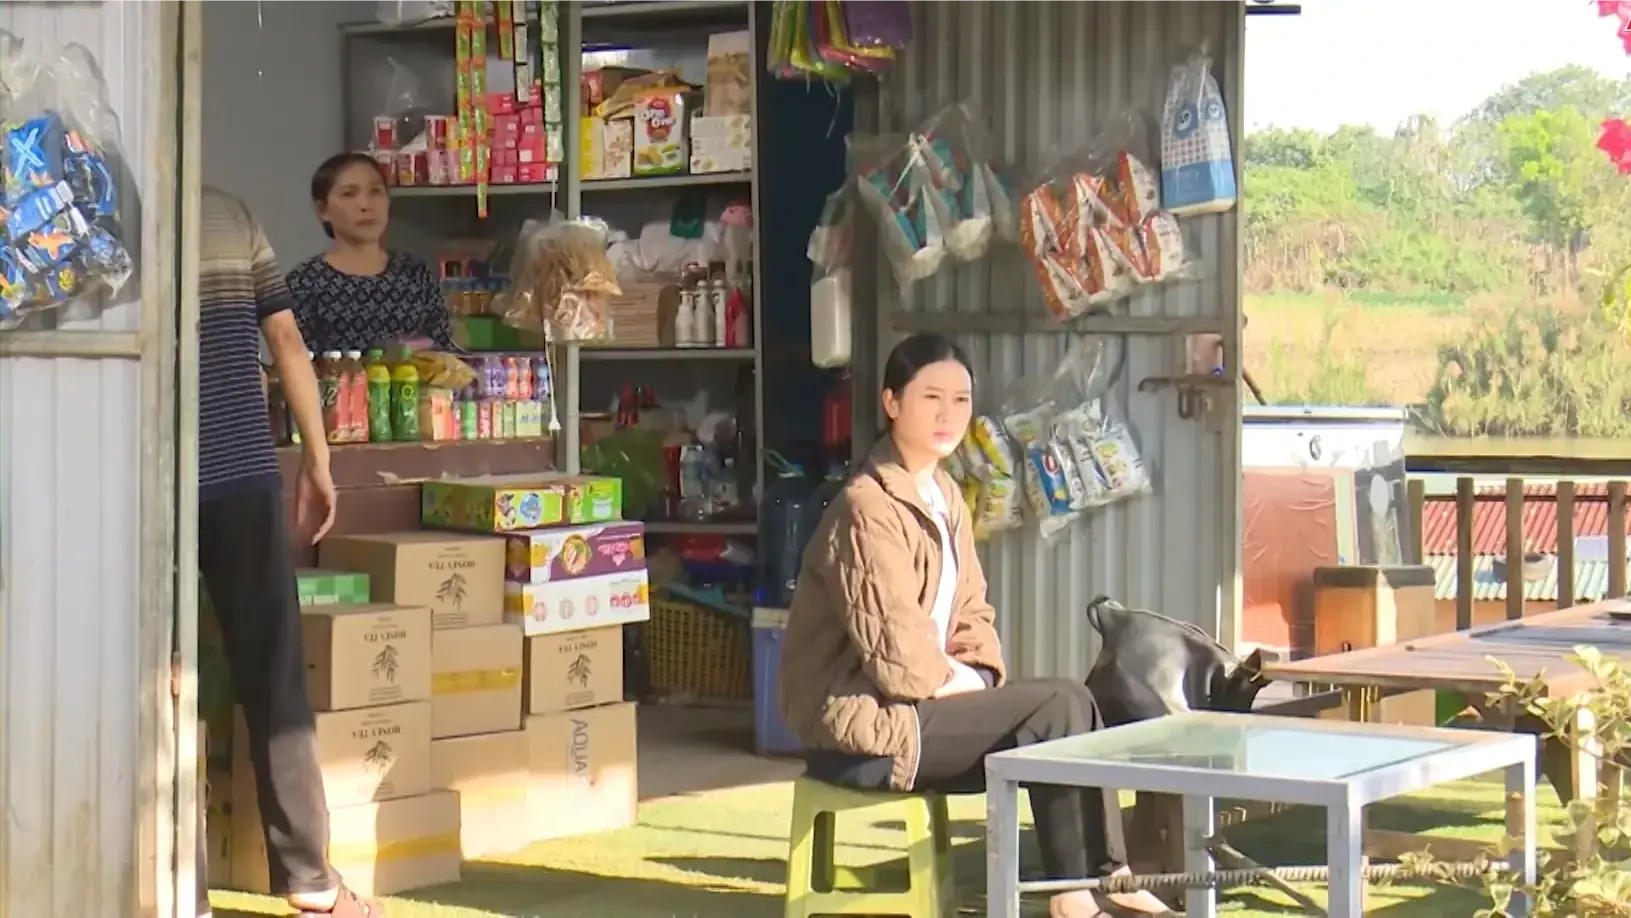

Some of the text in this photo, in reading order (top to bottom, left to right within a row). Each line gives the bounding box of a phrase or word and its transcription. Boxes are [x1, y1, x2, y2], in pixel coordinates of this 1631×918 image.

[428, 561, 476, 570] HONEY TEA
[363, 631, 406, 642] HONEY TEA
